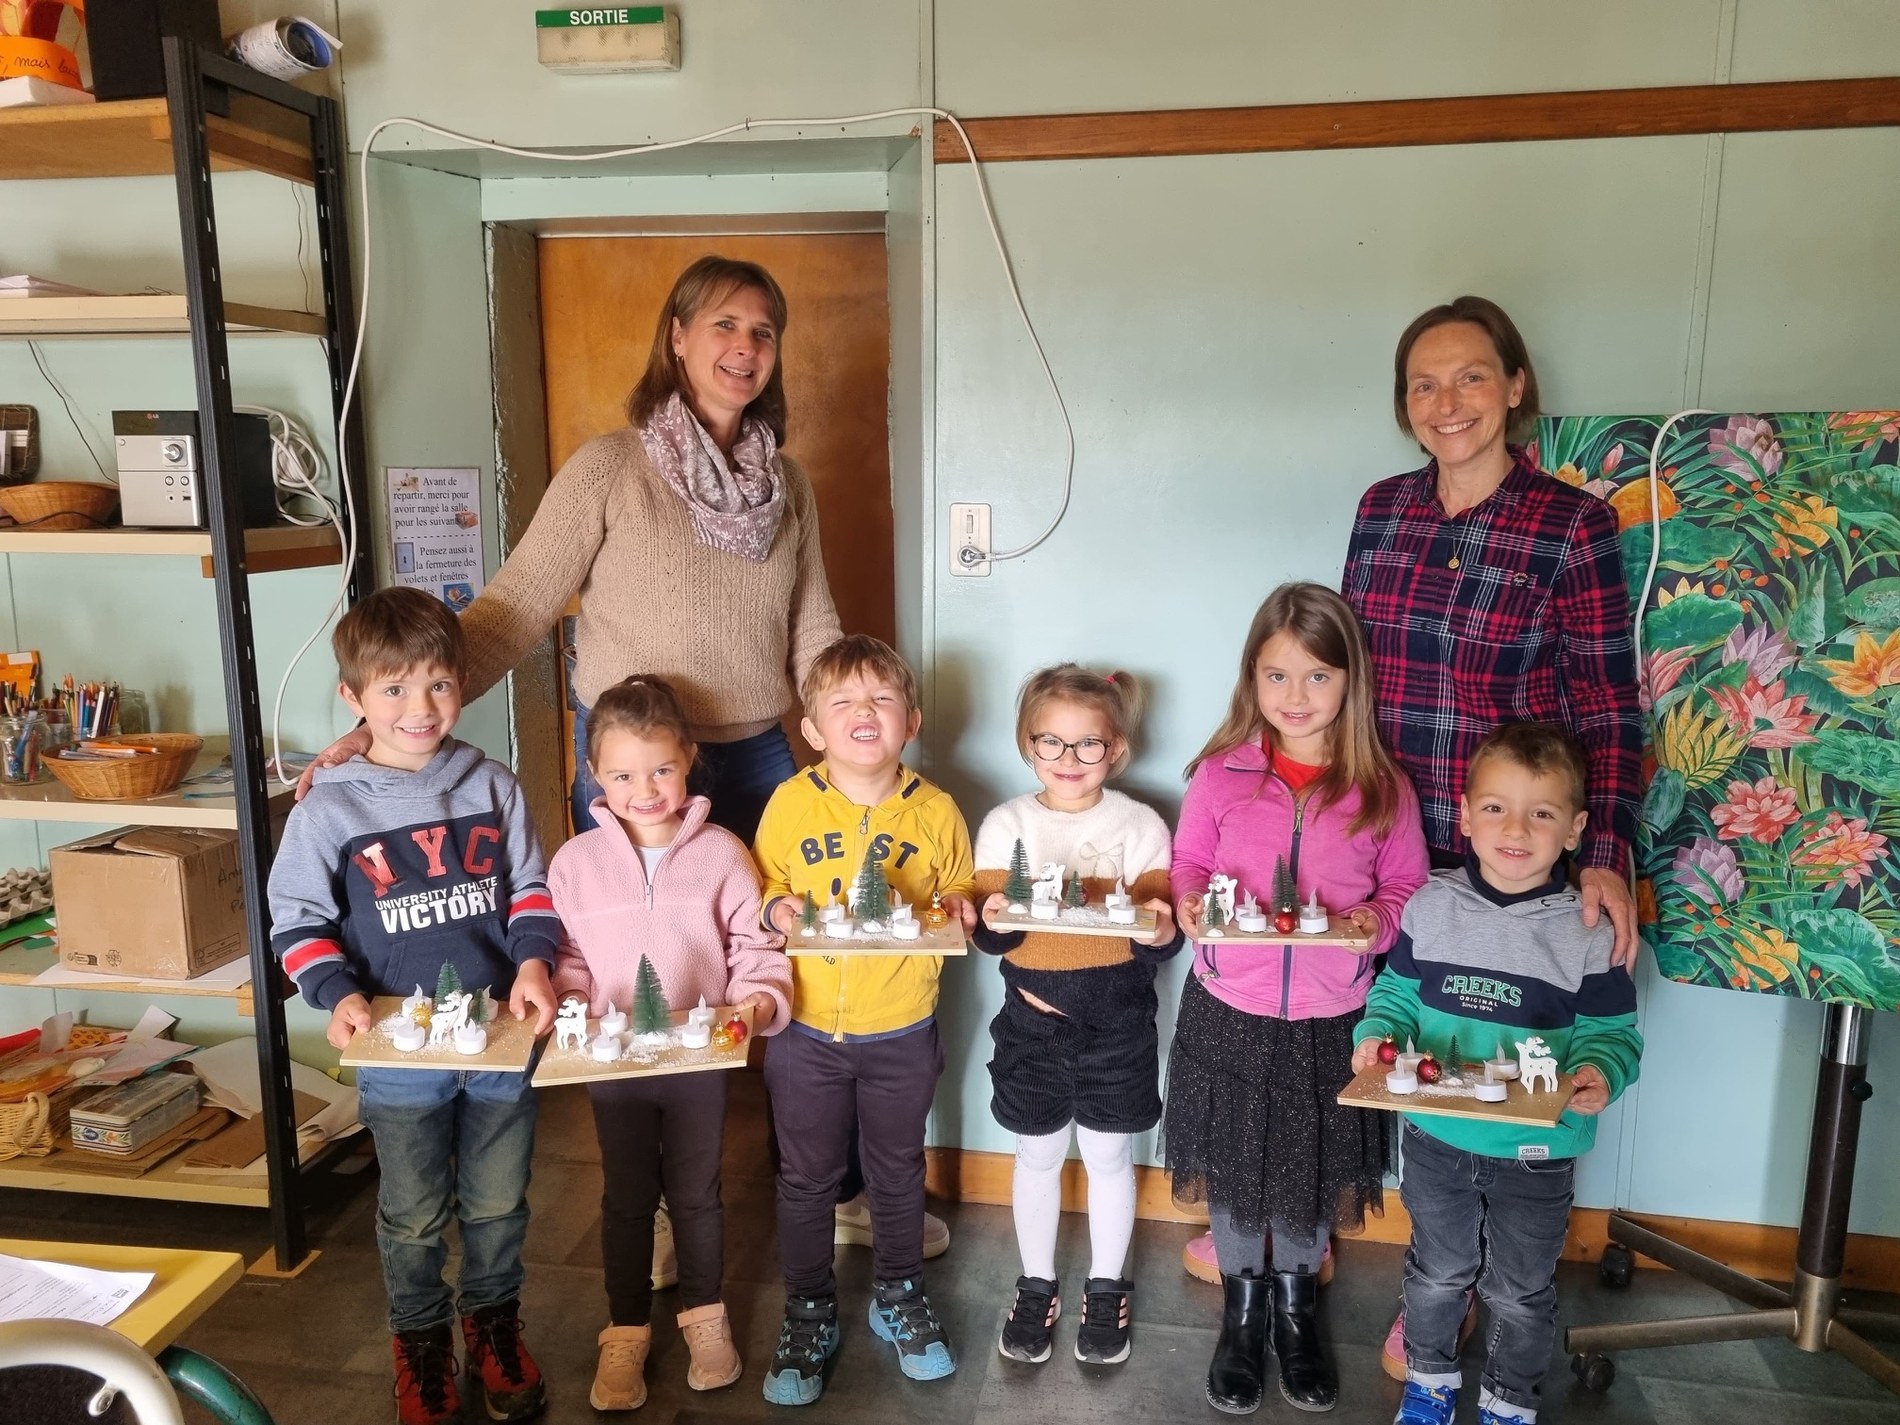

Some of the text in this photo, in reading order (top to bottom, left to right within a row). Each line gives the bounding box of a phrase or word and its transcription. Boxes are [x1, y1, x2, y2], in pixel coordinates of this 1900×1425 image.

[570, 9, 629, 25] SORTIE
[15, 56, 50, 69] mais
[423, 477, 458, 486] Avant de
[393, 490, 469, 502] repartir, merci pour
[394, 503, 468, 515] avoir rangé la salle
[395, 519, 415, 529] pour
[416, 517, 428, 526] les
[420, 545, 474, 556] Pensez aussi à
[416, 558, 477, 569] la fermeture des
[404, 571, 469, 584] volets et fenêtres
[801, 832, 919, 870] BEST
[353, 825, 500, 898] NYC
[375, 876, 498, 911] UNIVERSITY ATHLETE
[380, 887, 498, 934] VICTORY
[1441, 974, 1522, 1008] CREEKS
[1459, 995, 1499, 1007] ORIGINAL
[1461, 1002, 1493, 1013] Since 1974
